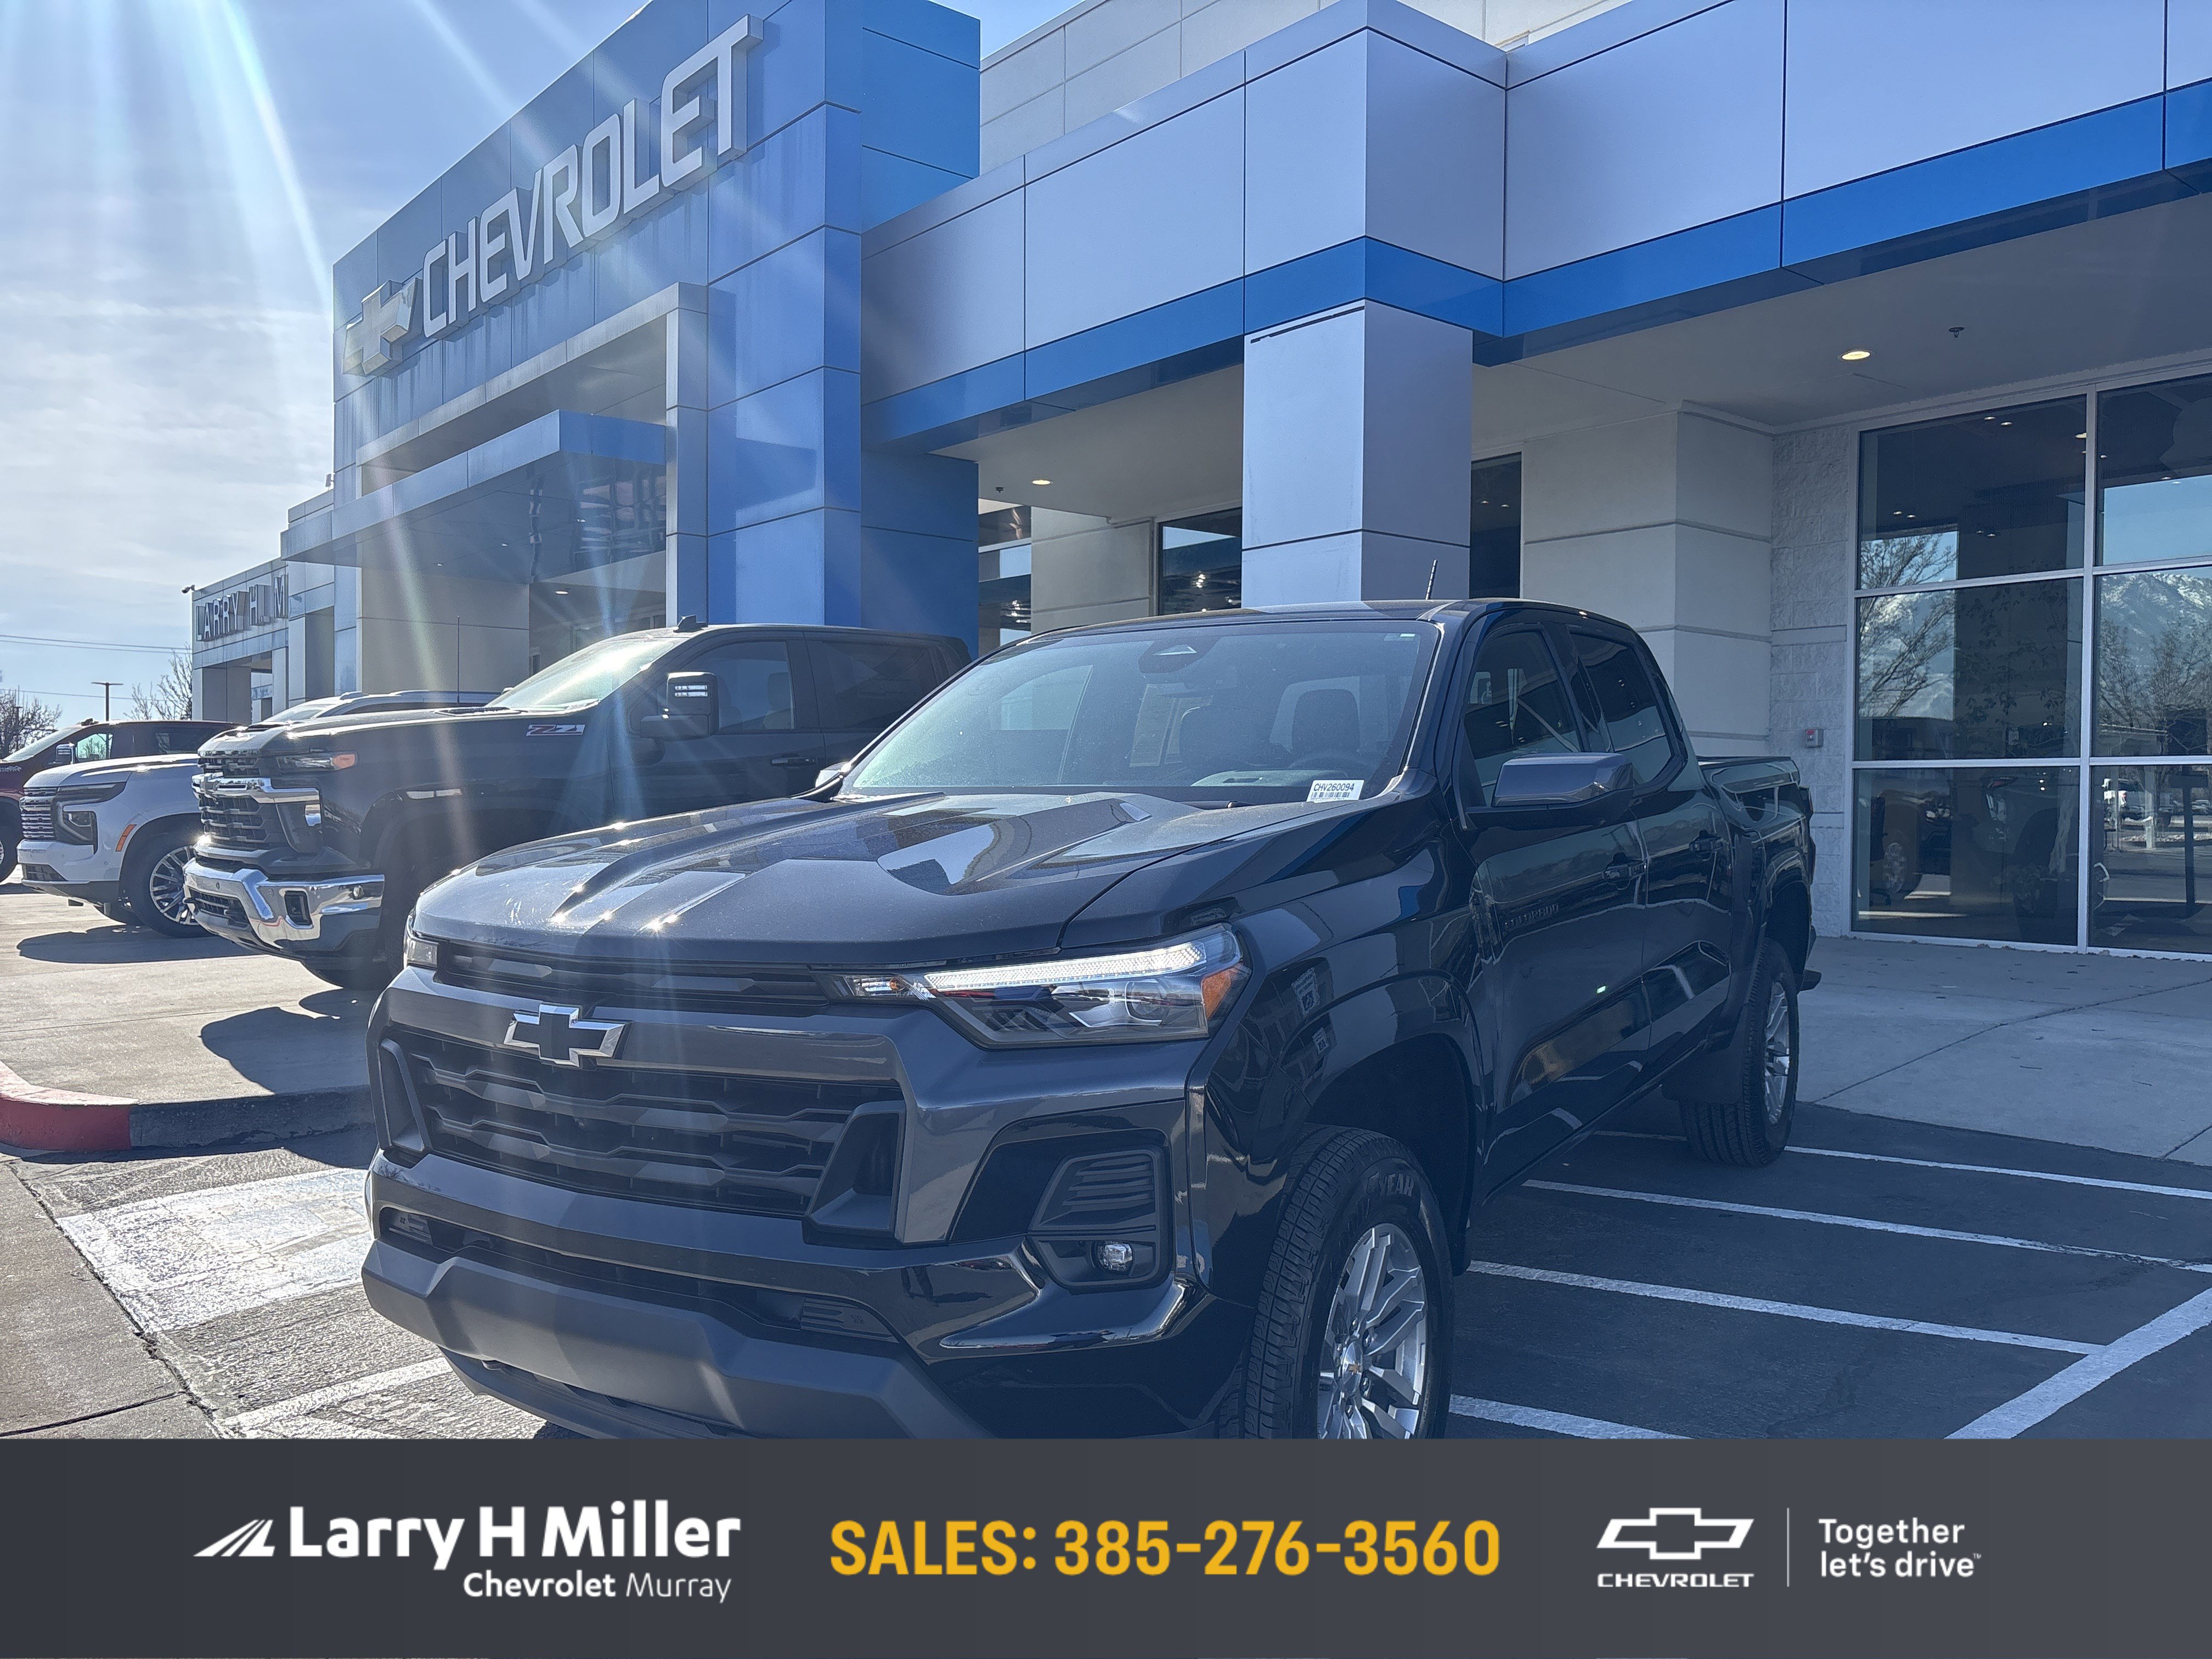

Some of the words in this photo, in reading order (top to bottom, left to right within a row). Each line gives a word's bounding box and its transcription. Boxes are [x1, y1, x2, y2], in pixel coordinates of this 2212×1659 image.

[423, 14, 764, 338] CHEVROLET
[196, 591, 244, 641] LARRY
[1313, 783, 1355, 792] CHV260094
